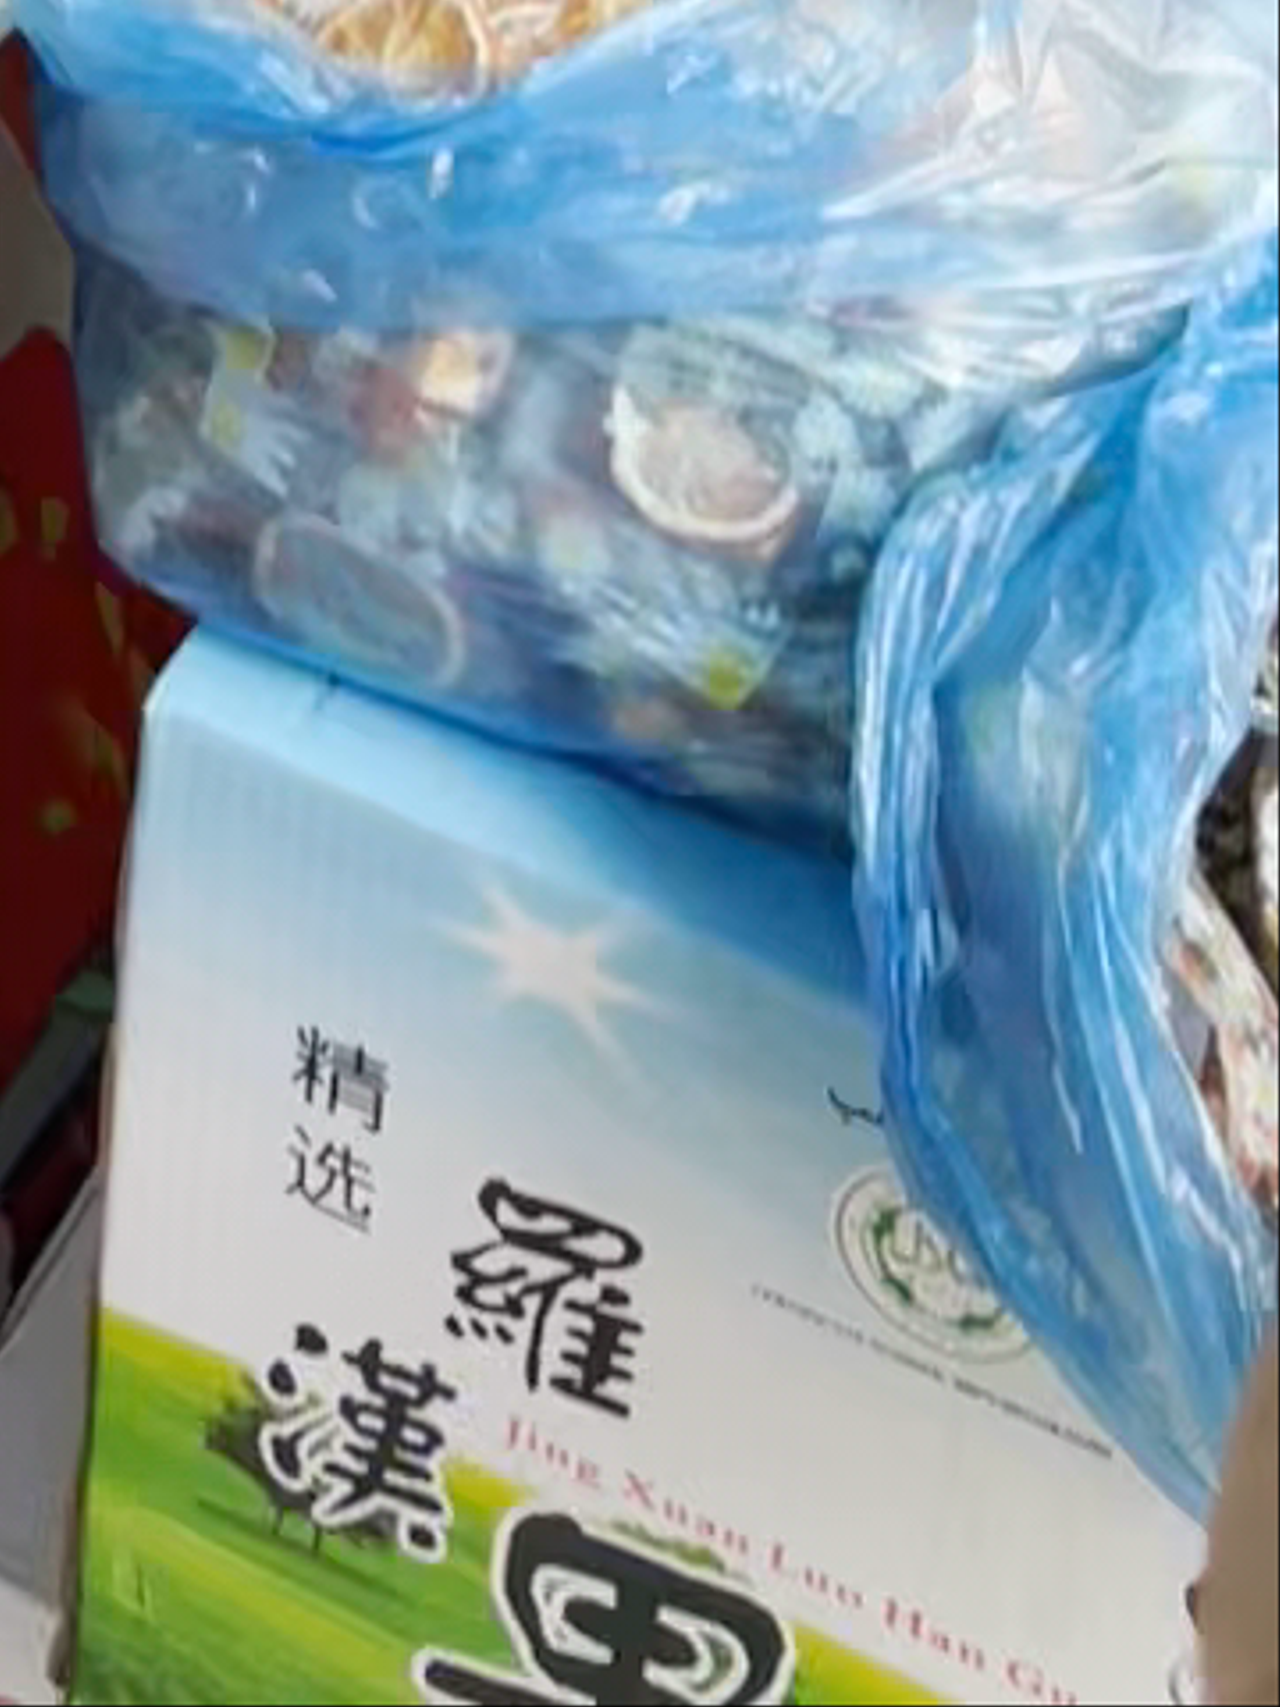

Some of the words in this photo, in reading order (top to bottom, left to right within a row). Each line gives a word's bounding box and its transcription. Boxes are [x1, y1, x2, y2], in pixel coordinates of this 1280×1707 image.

[284, 1022, 392, 1238] 精选
[504, 1416, 604, 1489] Jing
[621, 1469, 752, 1556] Xuan
[768, 1542, 867, 1612] Luo
[884, 1597, 988, 1672] Han
